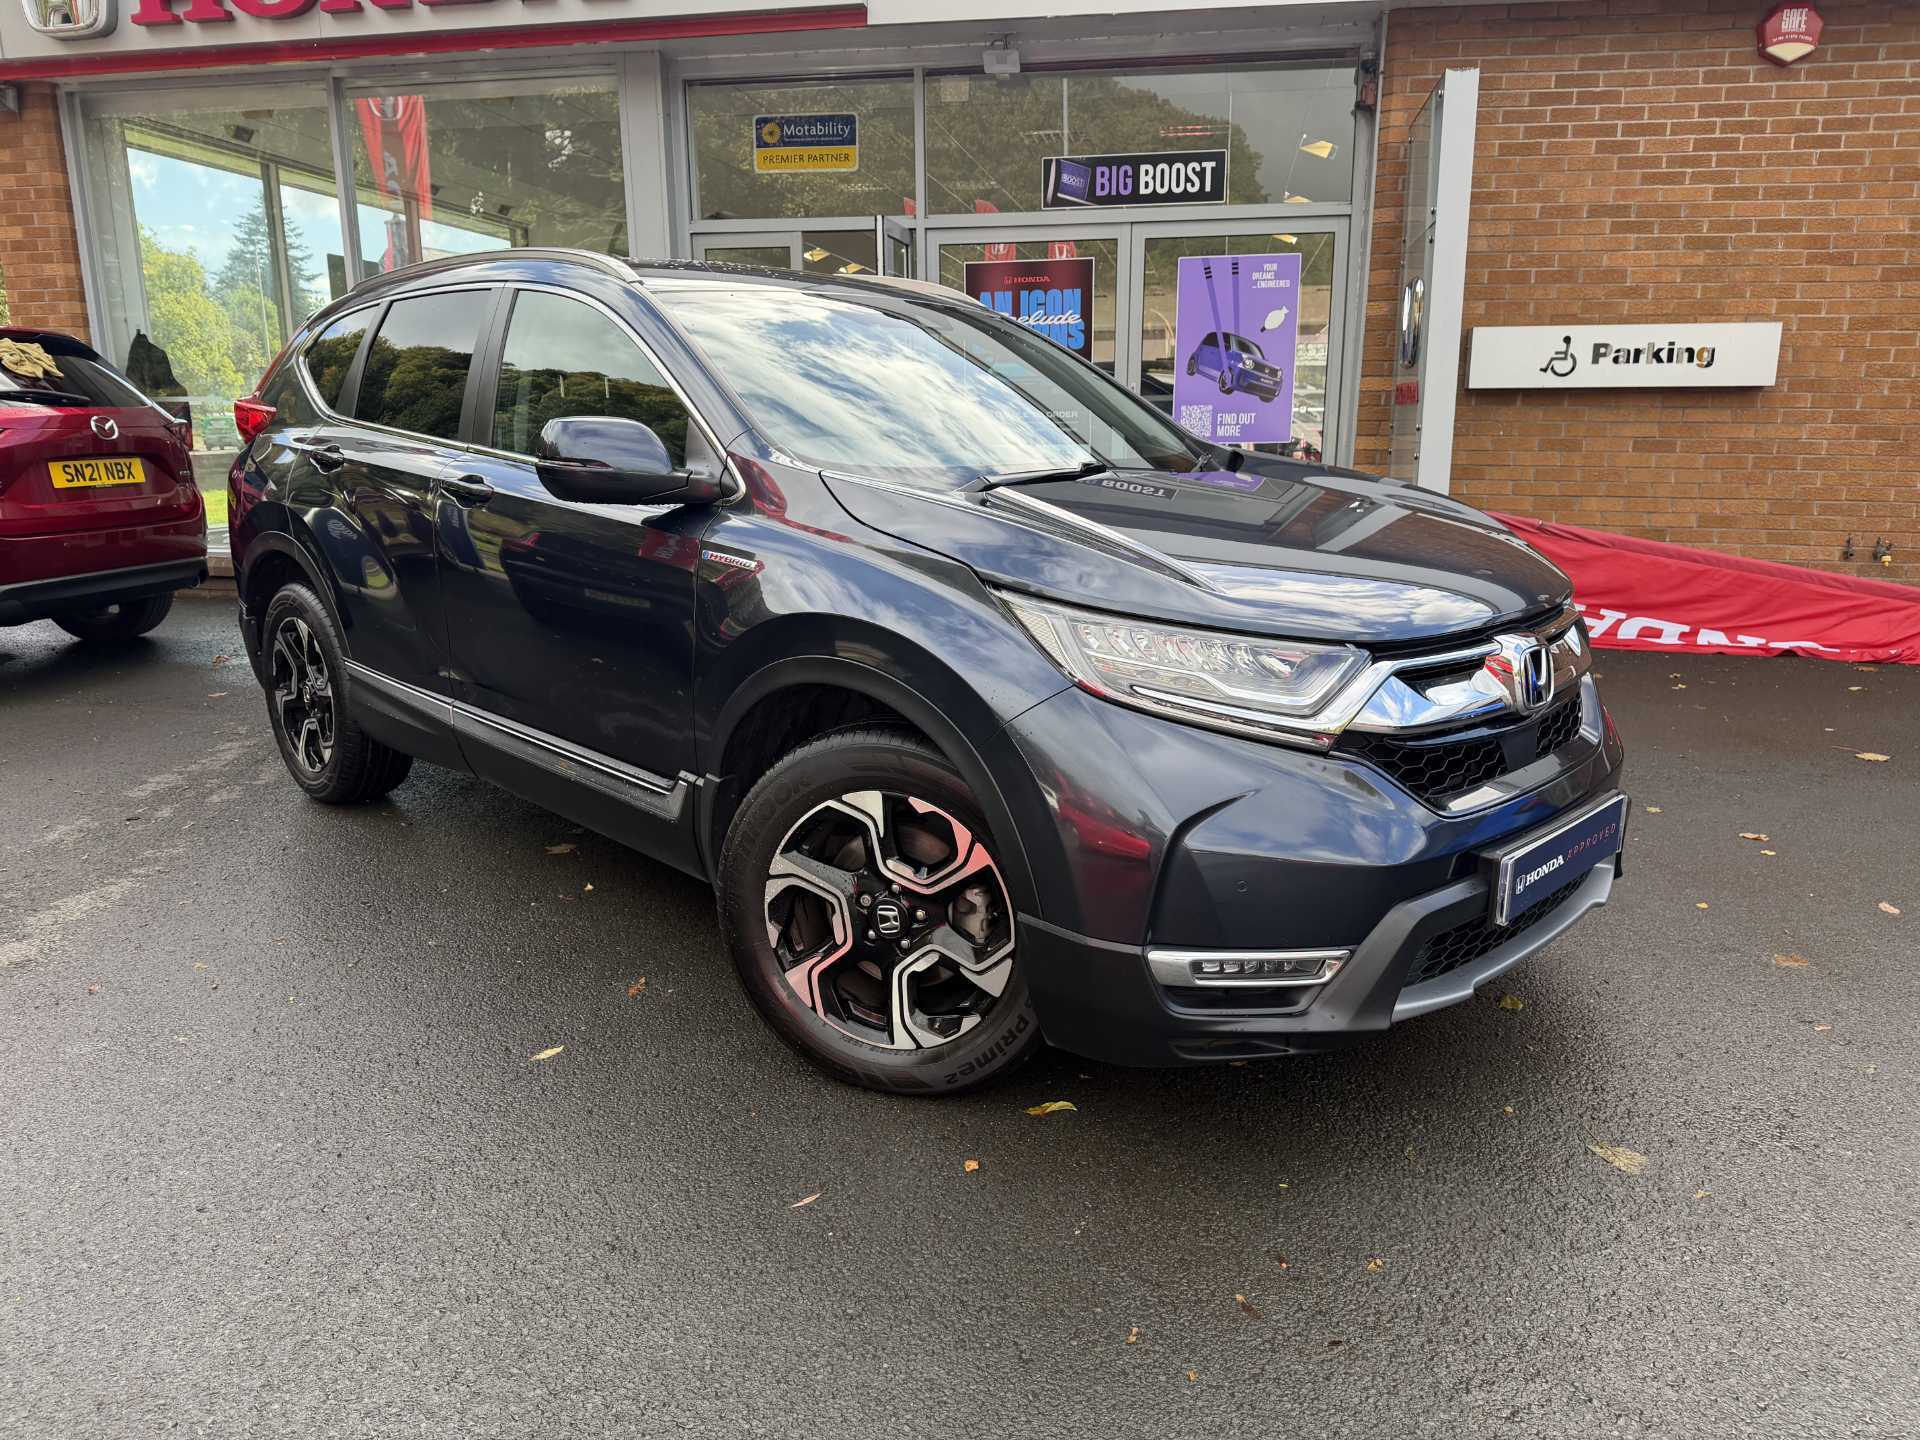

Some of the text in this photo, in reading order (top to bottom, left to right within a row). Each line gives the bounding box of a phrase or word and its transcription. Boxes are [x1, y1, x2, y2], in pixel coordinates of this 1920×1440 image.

[783, 121, 851, 138] Motability
[762, 152, 850, 165] PREMIER PARTNER
[1095, 161, 1217, 197] BIG BOOST
[1263, 263, 1278, 272] YOUR
[1013, 275, 1051, 284] HONDA
[1252, 271, 1275, 281] DREAMS
[979, 288, 1082, 317] AN ICON
[1591, 341, 1716, 369] Parking
[1217, 413, 1256, 425] FIND OUT
[1216, 425, 1241, 437] MORE
[62, 461, 136, 483] SN21 NBX
[709, 552, 752, 568] HYBRID
[1525, 823, 1617, 887] HONDA APPROVED
